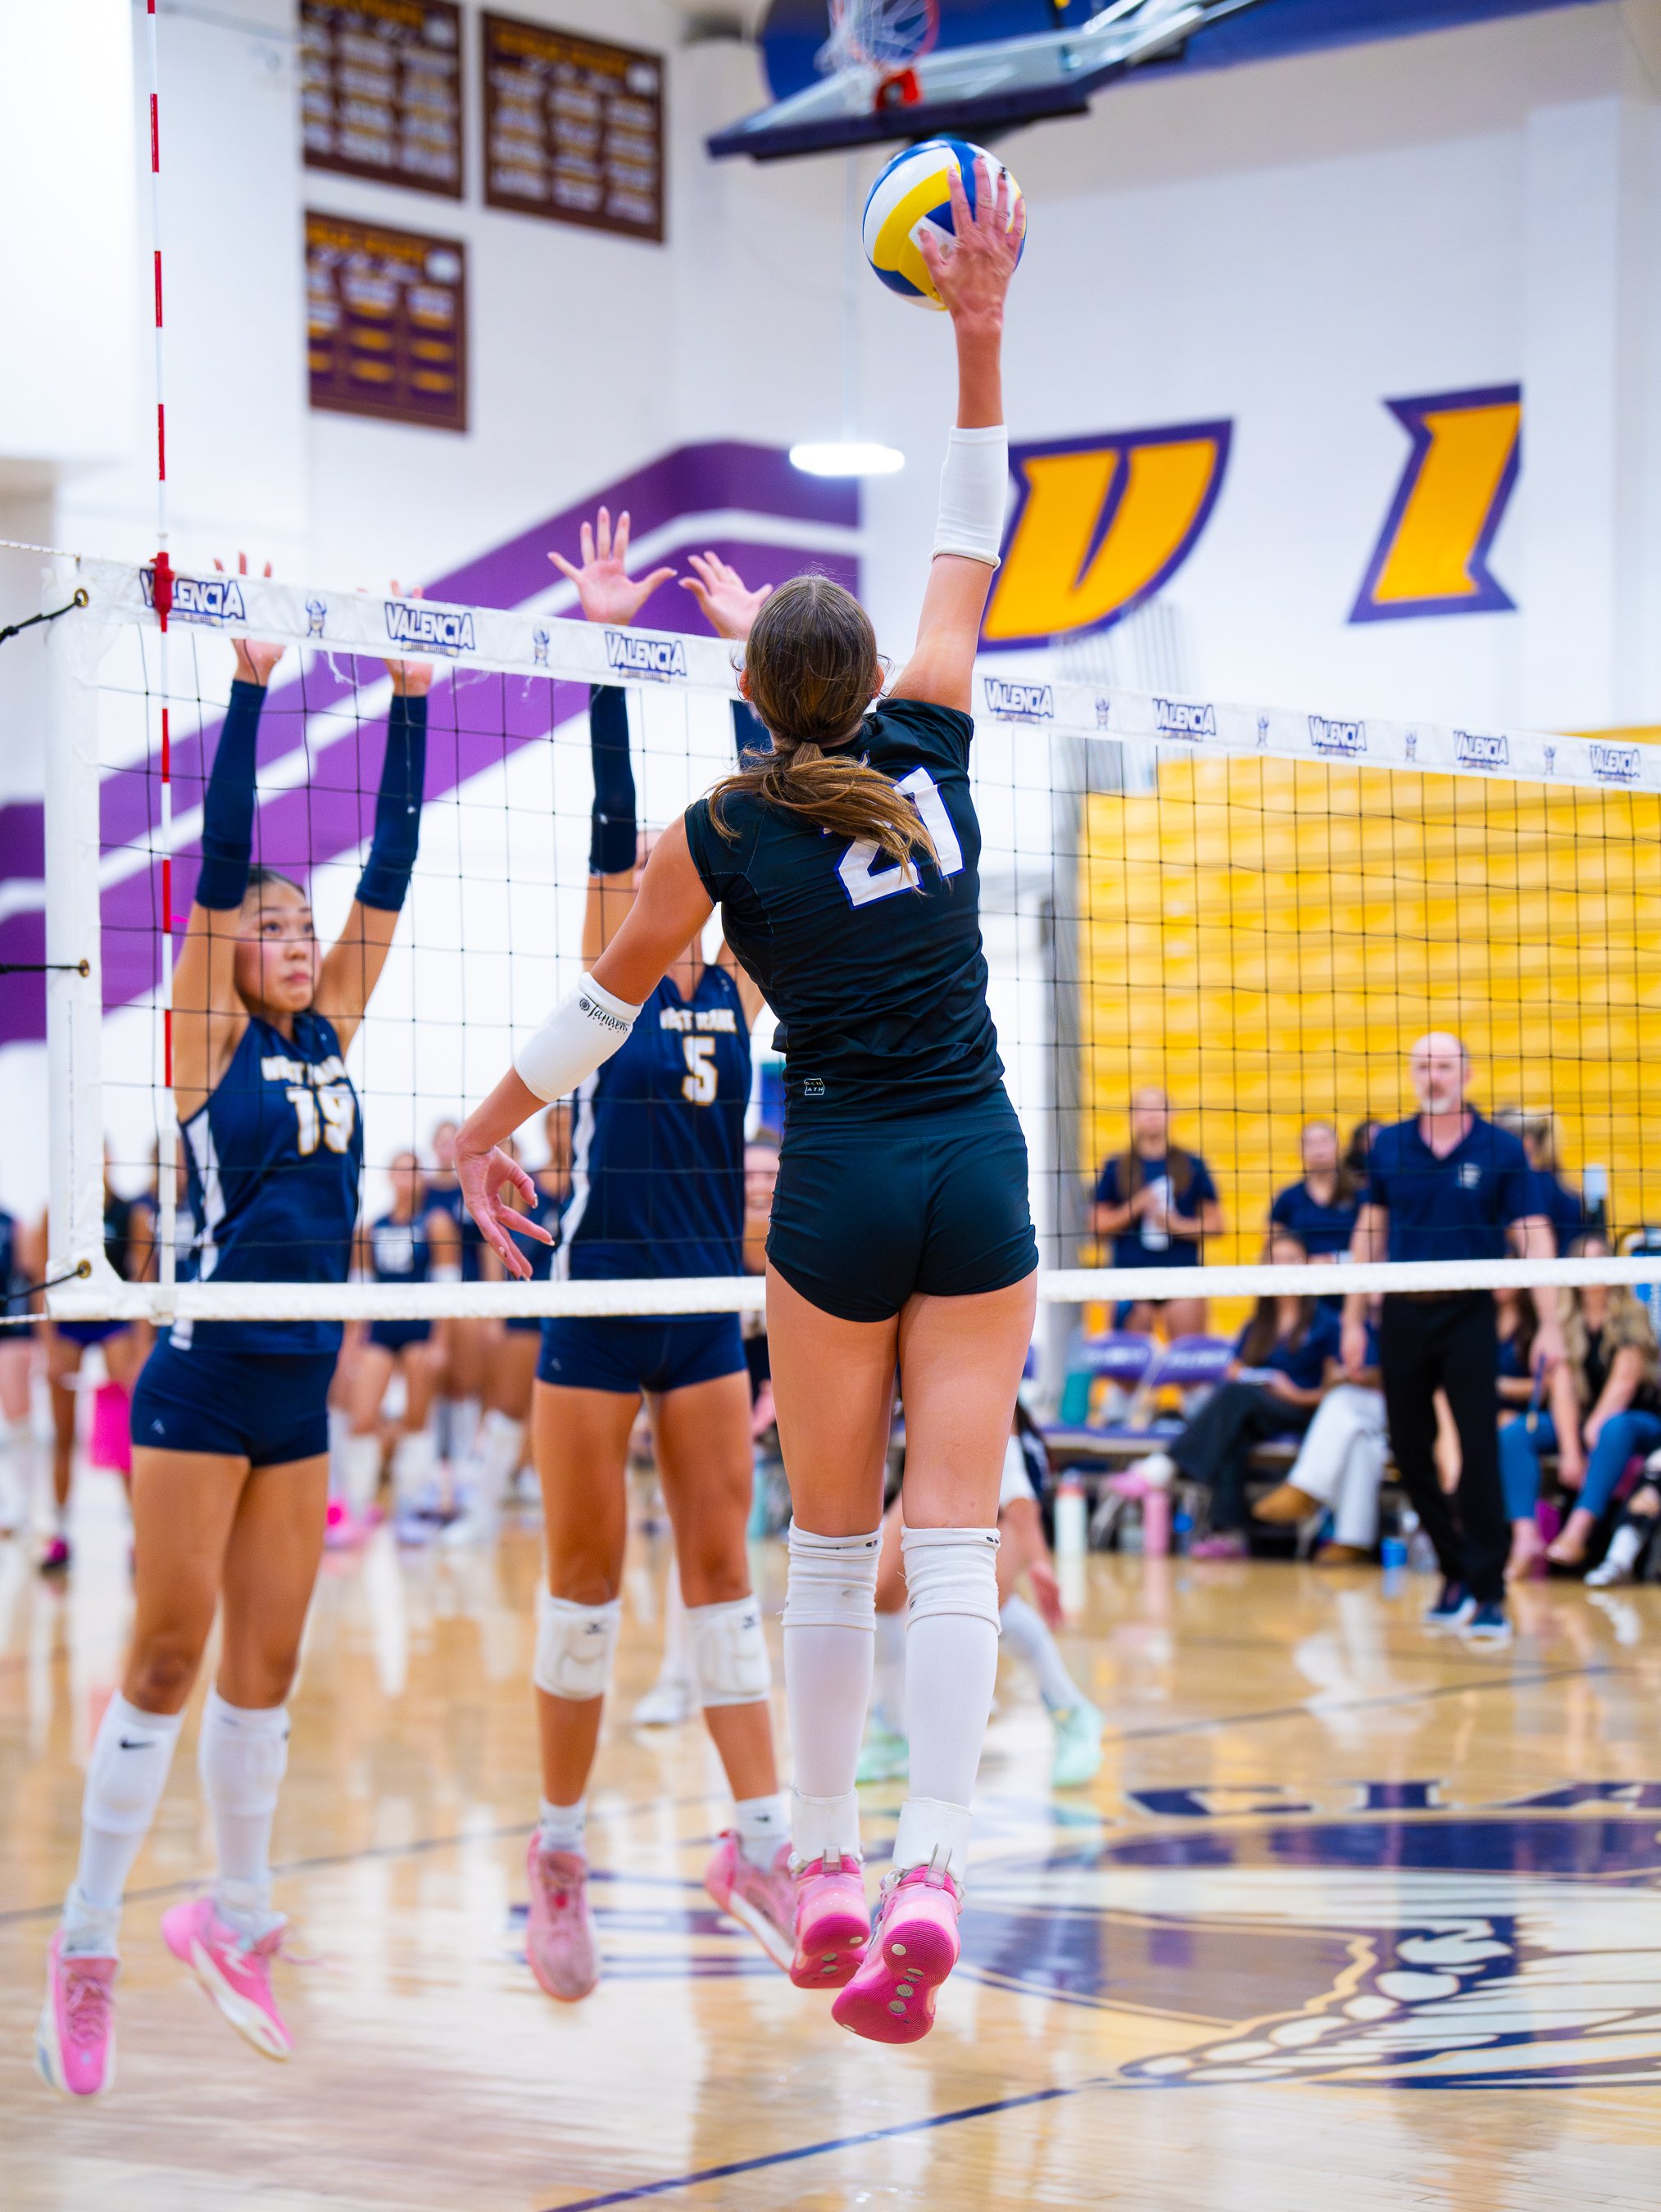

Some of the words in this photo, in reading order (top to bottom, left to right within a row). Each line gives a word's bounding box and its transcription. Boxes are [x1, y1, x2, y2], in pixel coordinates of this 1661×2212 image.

[384, 601, 475, 650] VALENCIA
[605, 631, 687, 676] VALENCIA
[984, 678, 1054, 718] VALENCIA
[1151, 697, 1217, 736] VALENCIA
[1308, 714, 1368, 752] VALENCIA
[1452, 730, 1509, 765] VALENCIA
[1589, 745, 1641, 778] VALENCIA
[682, 1035, 719, 1106] 5
[285, 1083, 355, 1157] 19
